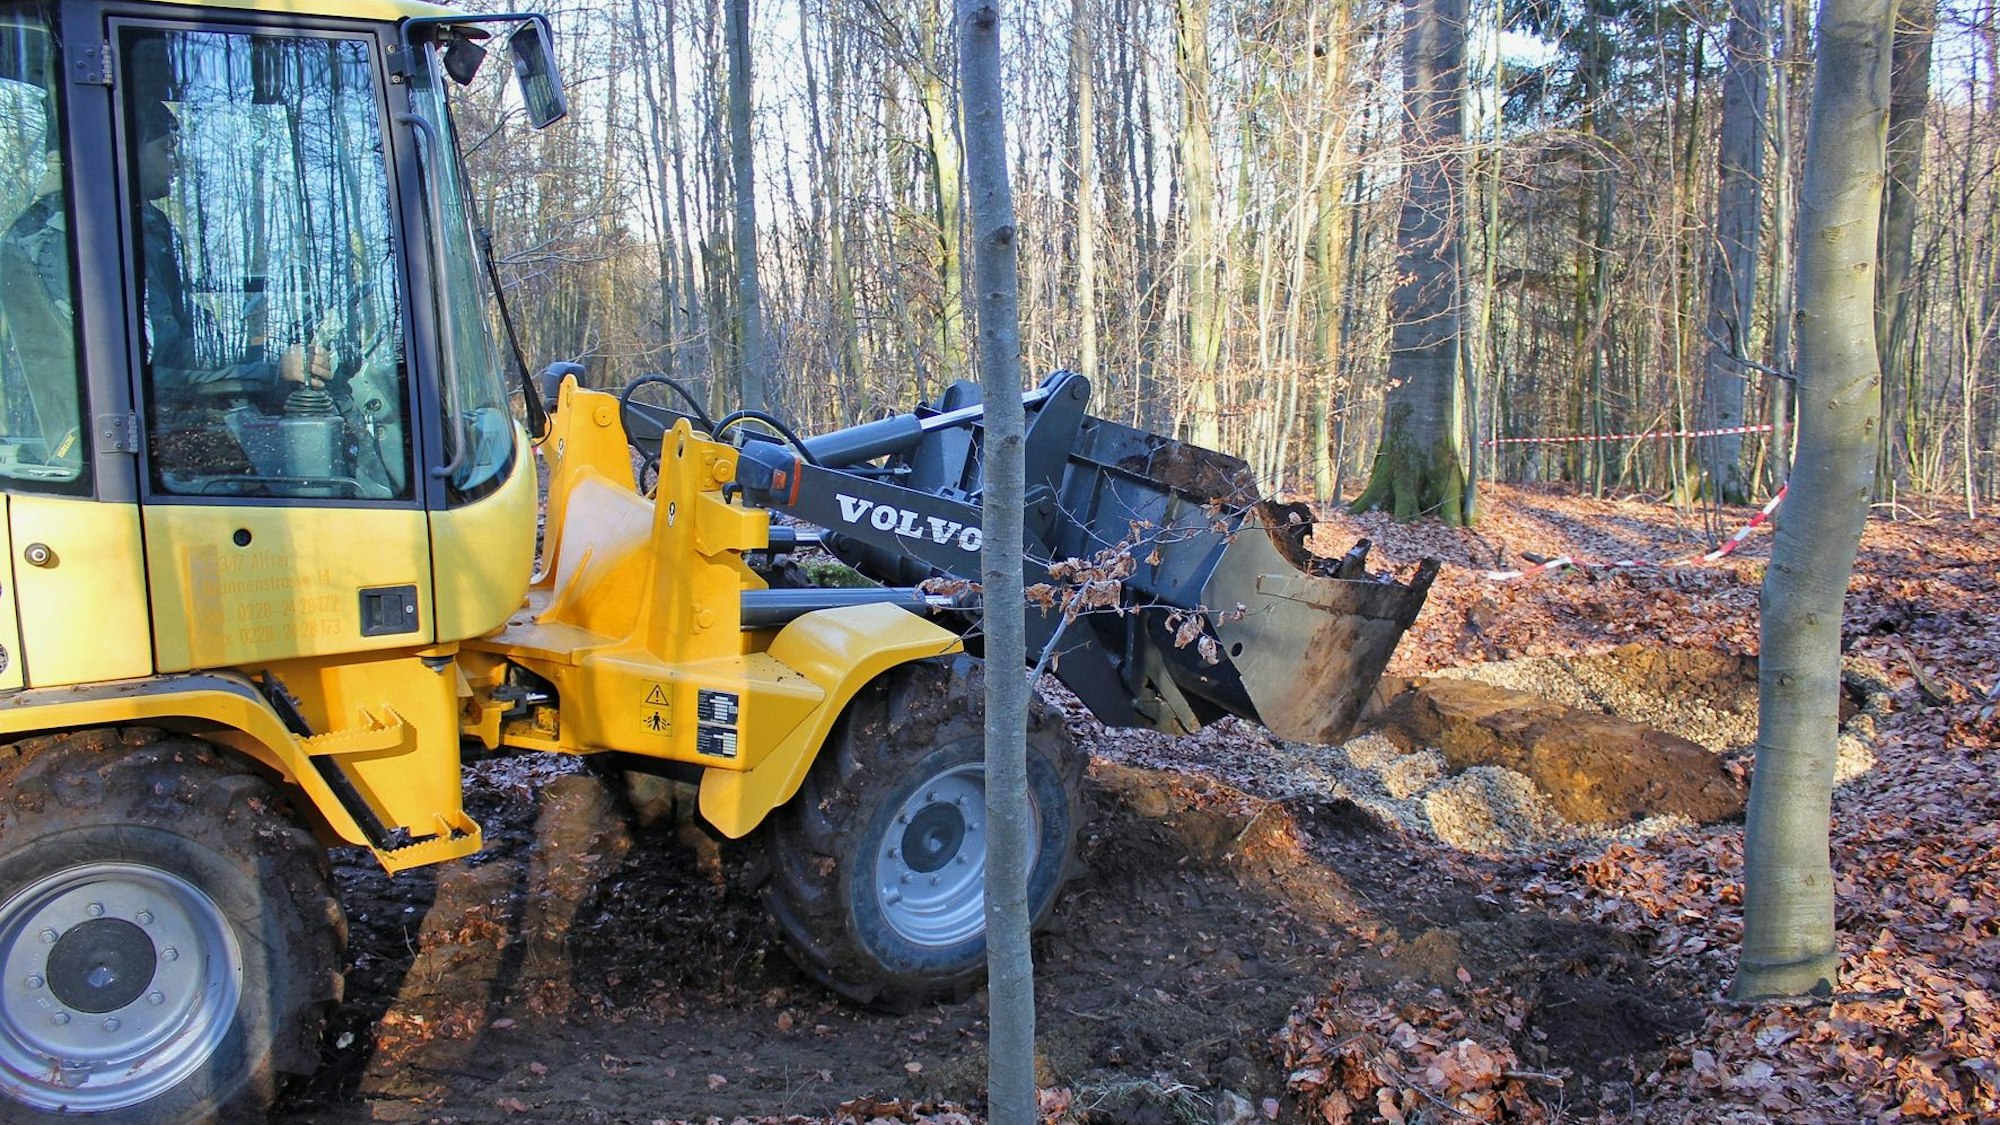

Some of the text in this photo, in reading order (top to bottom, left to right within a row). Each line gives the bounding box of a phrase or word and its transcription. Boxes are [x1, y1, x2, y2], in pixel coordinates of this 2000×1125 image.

[835, 493, 983, 552] VOLVO
[237, 601, 272, 620] 0228
[281, 599, 296, 616] 24
[239, 625, 273, 644] 0228
